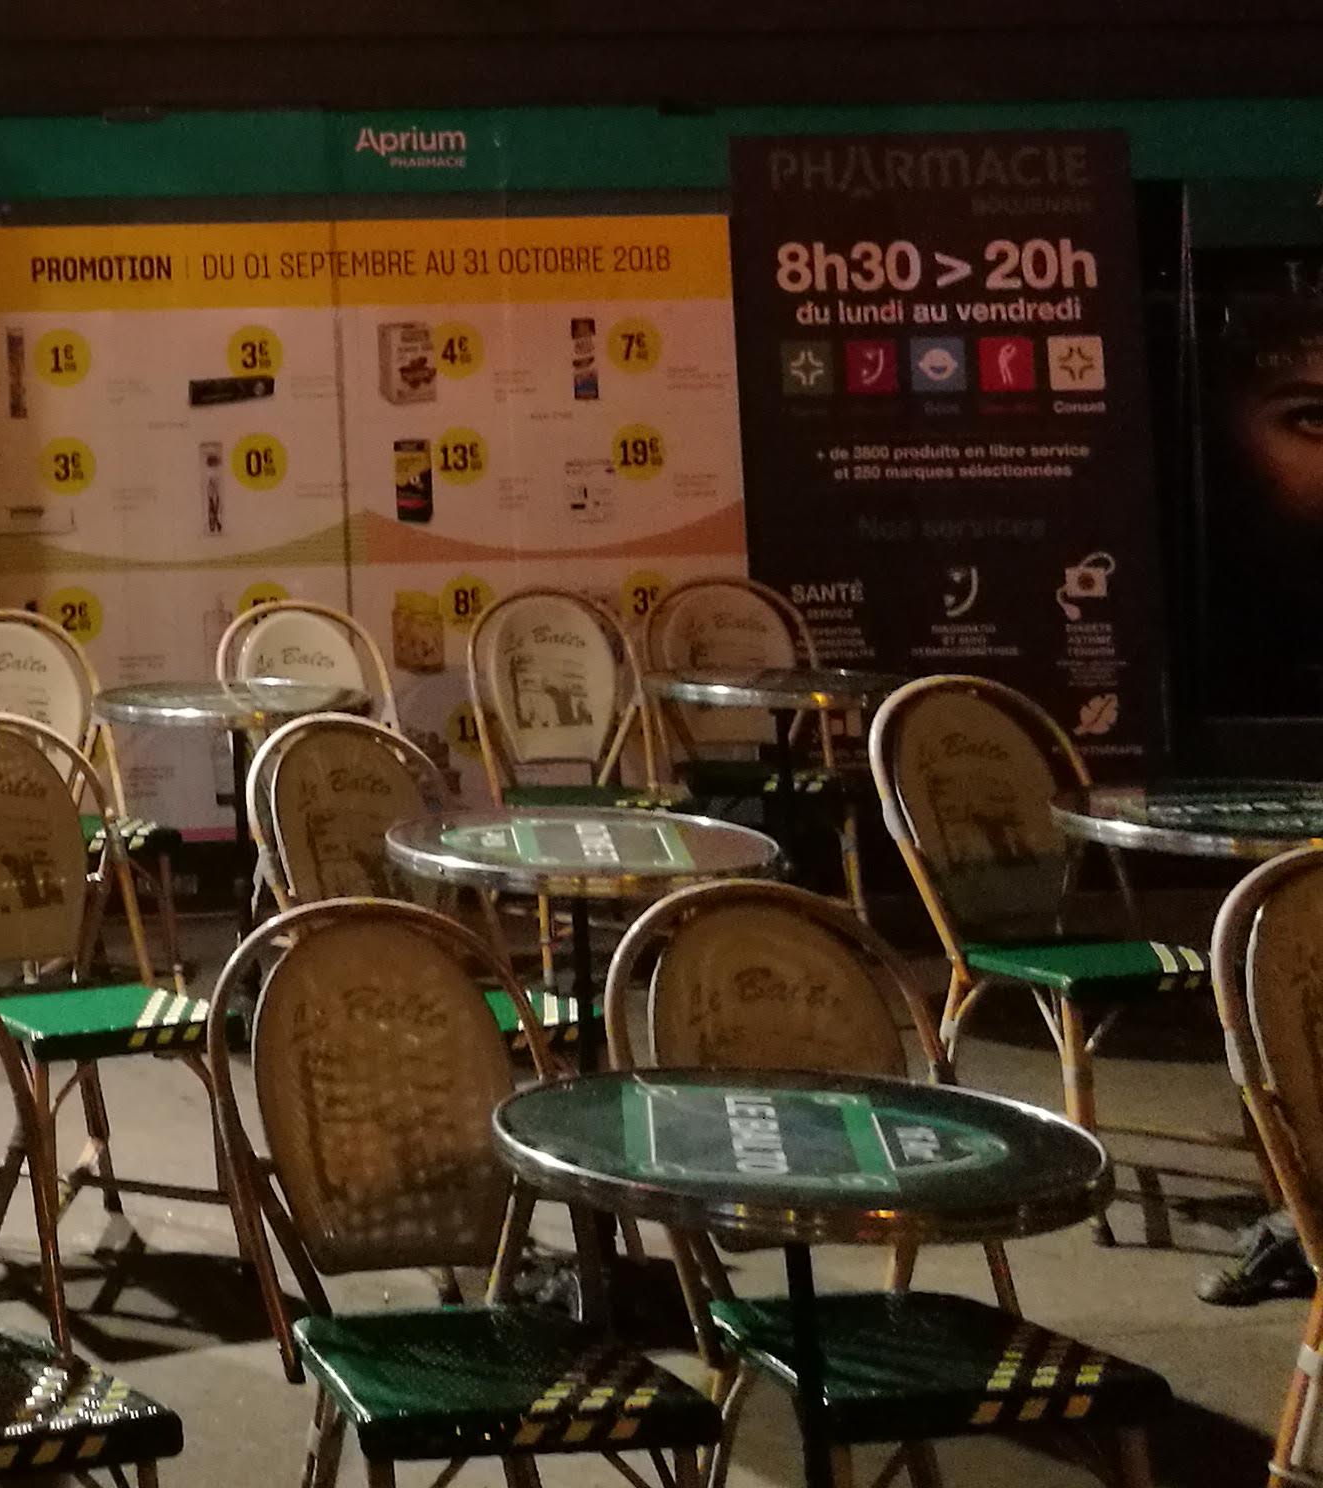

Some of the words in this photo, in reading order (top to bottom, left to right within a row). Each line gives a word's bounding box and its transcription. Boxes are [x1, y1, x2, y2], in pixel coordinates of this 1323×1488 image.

[354, 125, 466, 157] Aprium
[768, 144, 1089, 201] PHARMACIE
[30, 255, 172, 283] PROMOTION
[203, 254, 234, 280] DU
[244, 253, 269, 279] 01
[280, 250, 415, 278] SEPTEMBRE
[425, 250, 454, 275] AU
[464, 249, 490, 274] 31
[499, 247, 604, 274] OCTOBRE
[614, 245, 671, 272] 2018
[775, 239, 923, 294] 8h30
[984, 237, 1099, 290] 20h
[795, 299, 831, 326] du
[838, 298, 905, 325] lundi
[912, 302, 948, 323] au
[955, 296, 1083, 323] vendredi
[830, 446, 850, 462] de
[893, 443, 960, 462] produits
[965, 447, 985, 460] en
[990, 443, 1026, 459] libre
[1030, 443, 1091, 459] service
[834, 467, 850, 481] et
[886, 467, 954, 482] marques
[958, 462, 1073, 479] sélectionnées
[790, 577, 865, 604] SANTÉ
[280, 646, 336, 670] Balto
